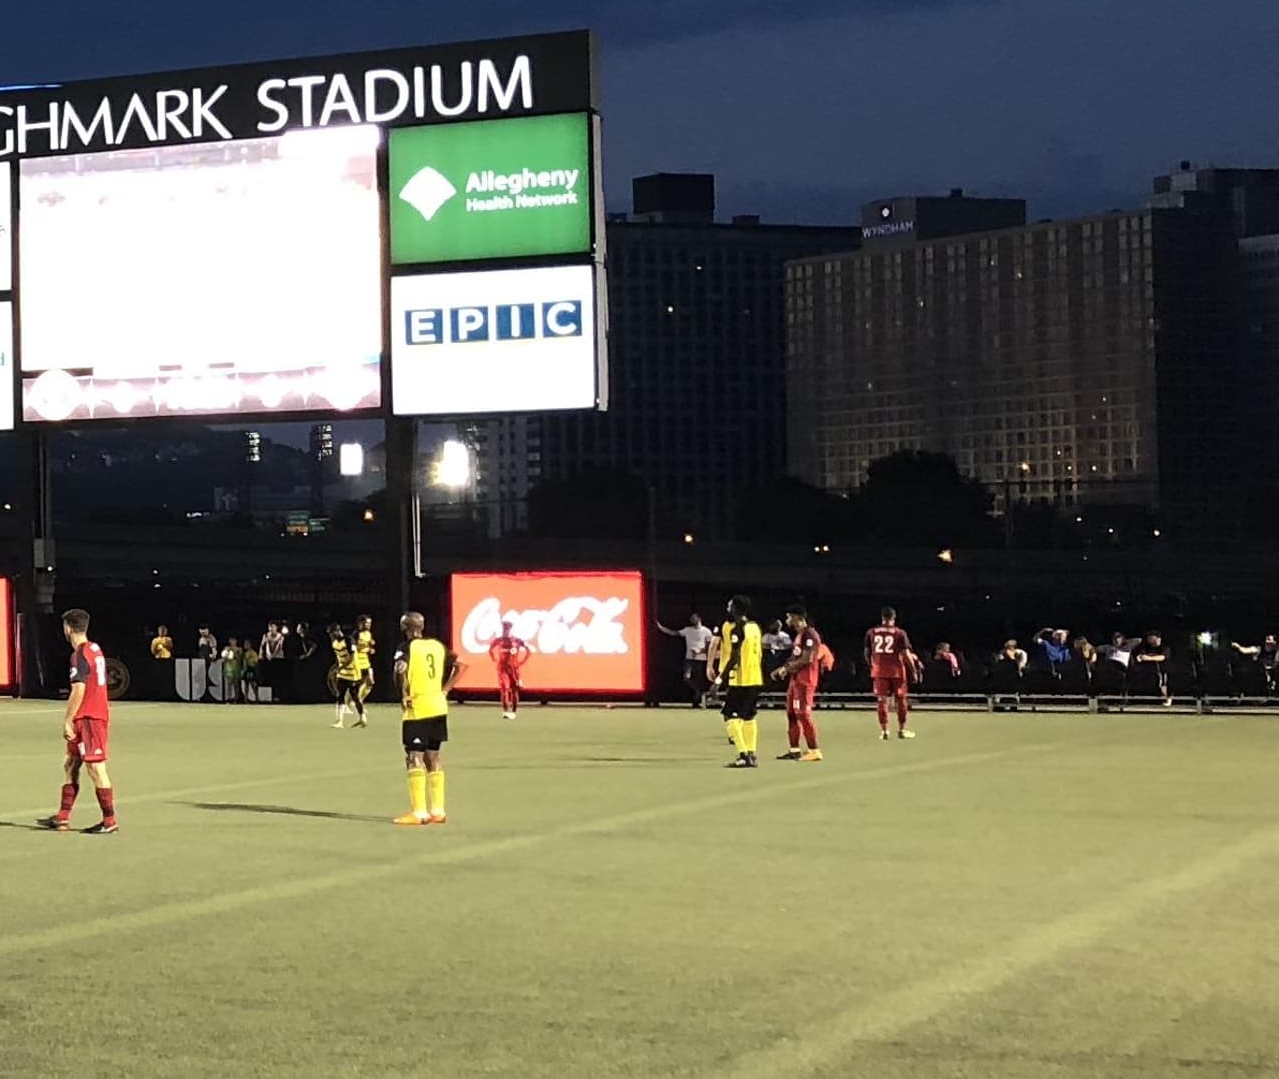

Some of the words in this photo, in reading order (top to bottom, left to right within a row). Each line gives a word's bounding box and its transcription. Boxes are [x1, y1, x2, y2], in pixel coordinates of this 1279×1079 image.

[255, 54, 533, 133] STADIUM
[465, 167, 580, 194] Allegheny
[465, 195, 514, 212] Health
[515, 190, 578, 209] Network
[861, 220, 914, 239] WYNDHAM
[410, 302, 578, 344] EPIC
[873, 634, 895, 655] 22
[425, 653, 436, 680] 3
